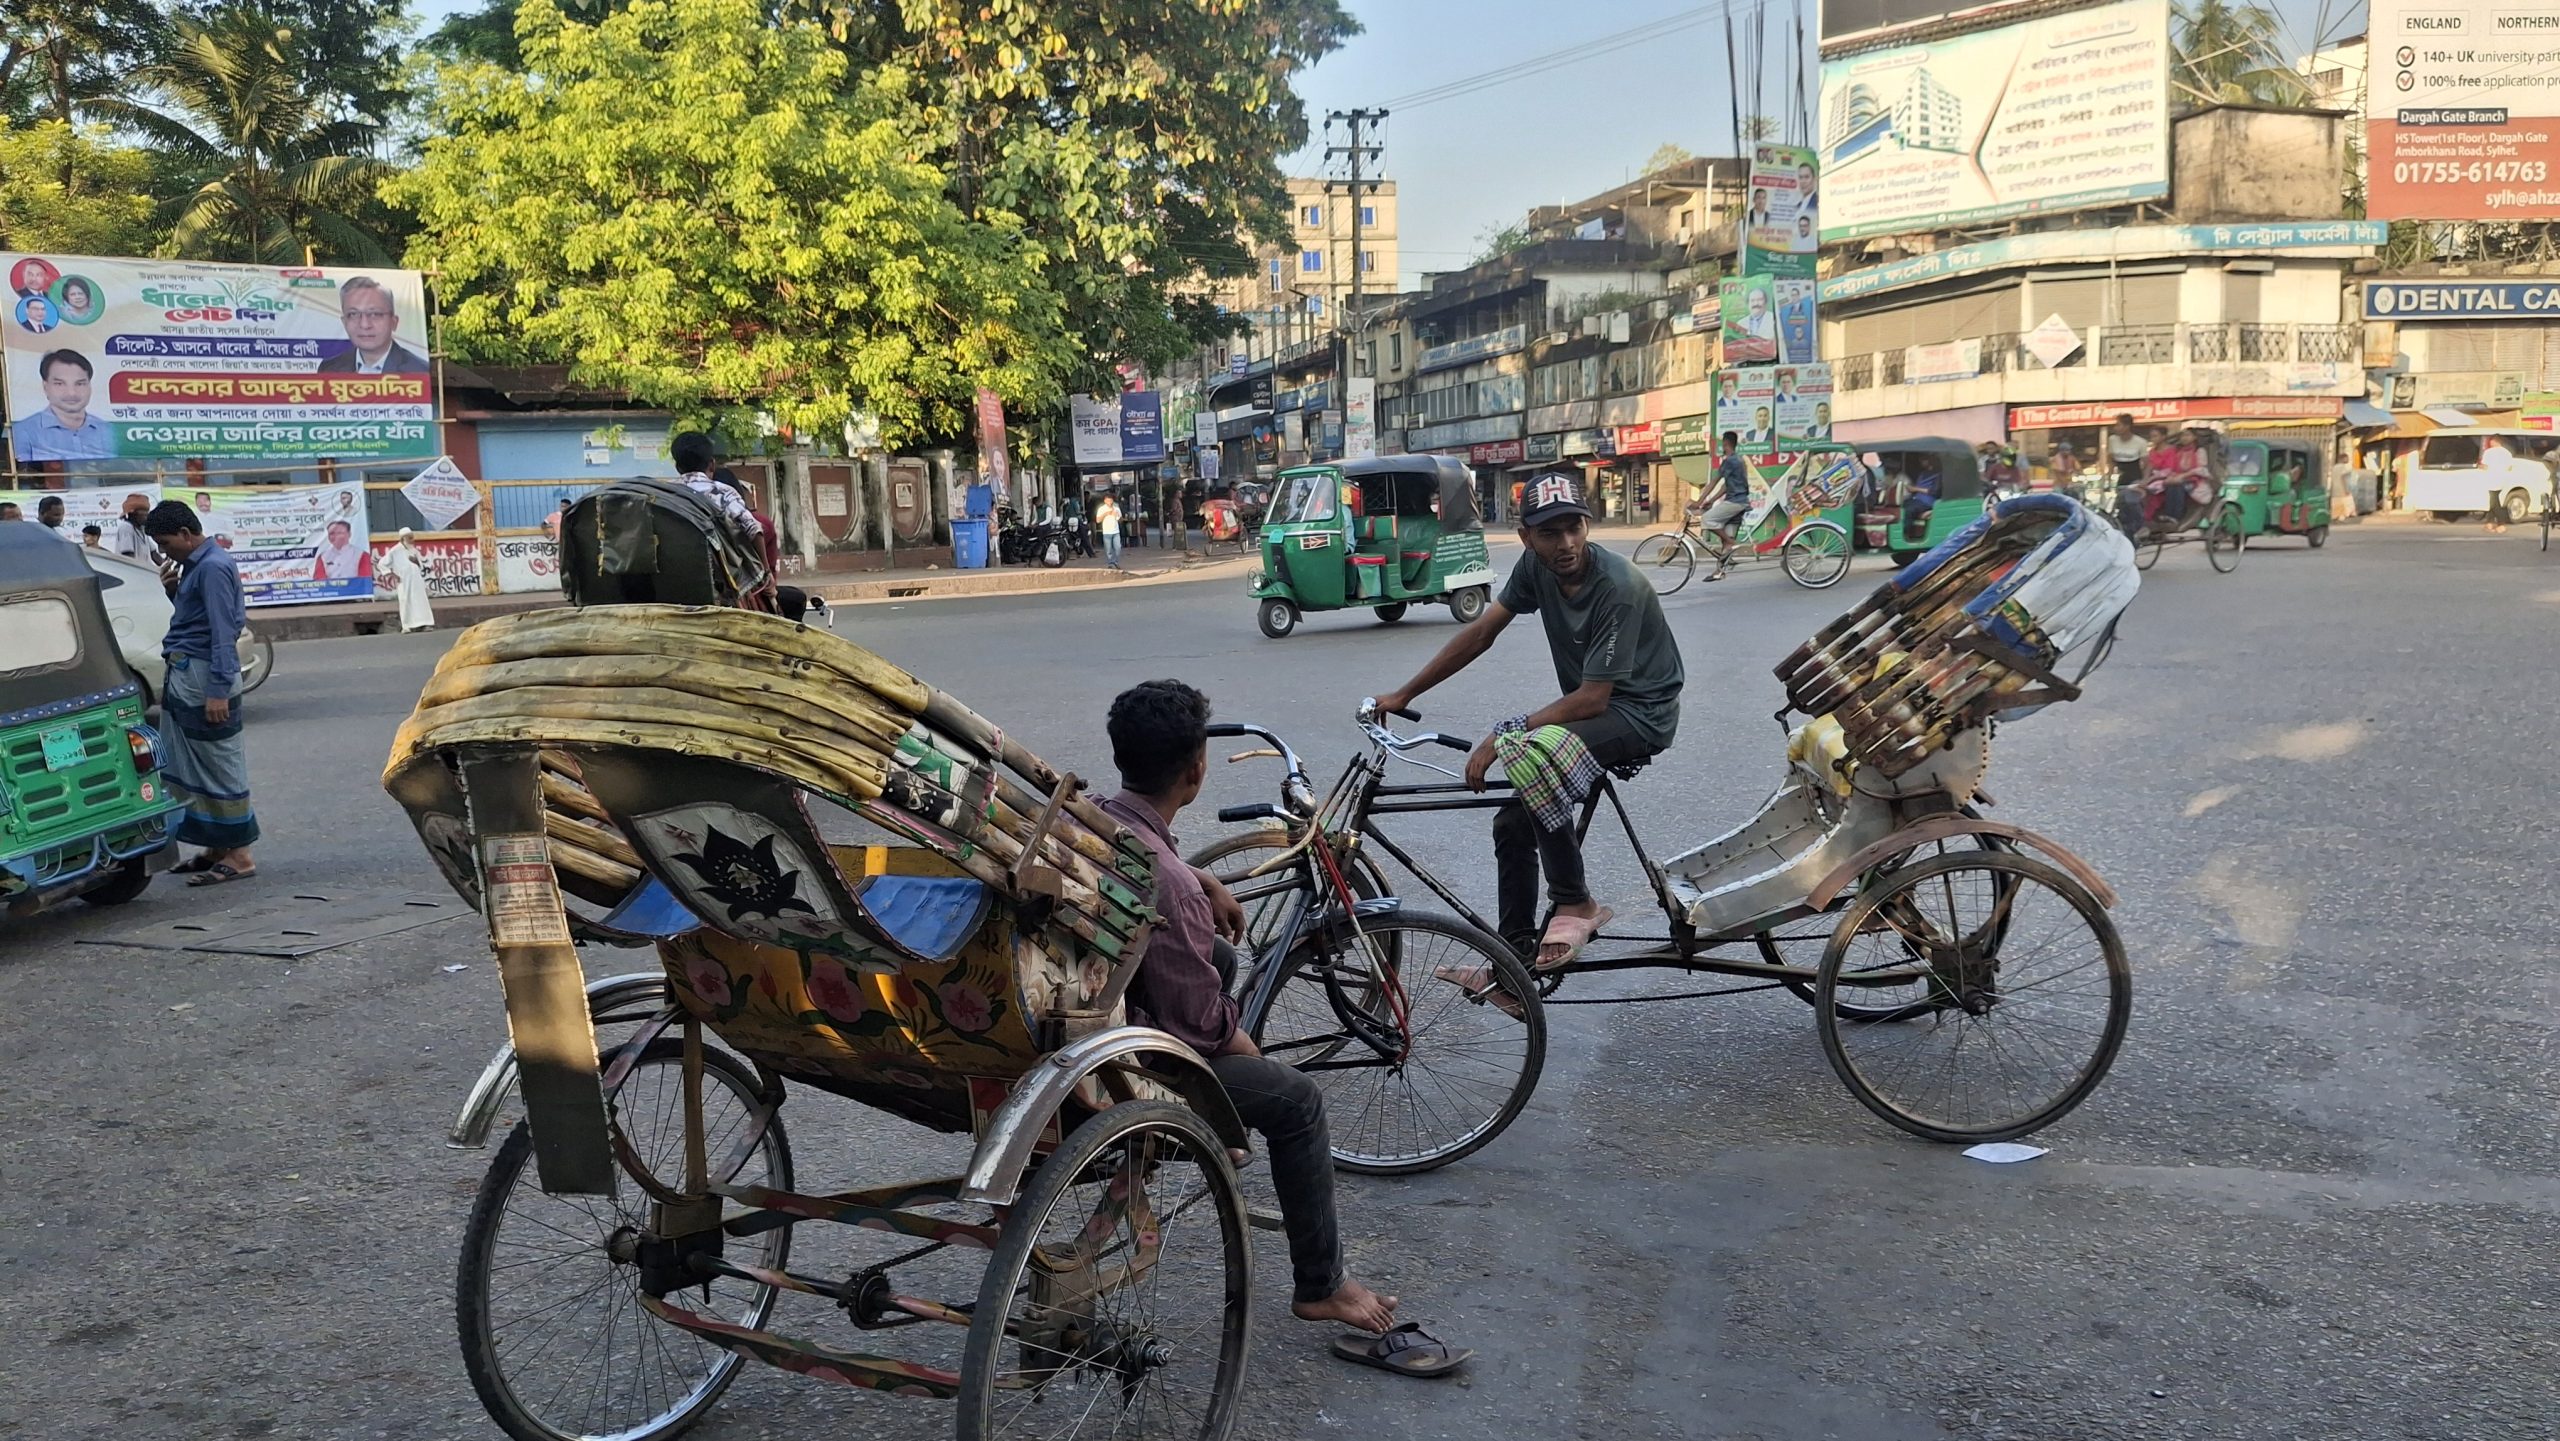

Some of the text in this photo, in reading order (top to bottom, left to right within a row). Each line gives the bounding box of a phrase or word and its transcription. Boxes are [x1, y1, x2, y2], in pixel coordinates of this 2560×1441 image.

[2406, 17, 2461, 29] ENGLAND
[2498, 17, 2559, 28] NORTHERN
[2423, 51, 2453, 63] 140+
[2457, 51, 2474, 62] UK
[2478, 51, 2534, 65] university
[2423, 76, 2456, 87] 100%
[2458, 75, 2481, 87] free
[2484, 75, 2544, 89] application
[2400, 110, 2505, 125] Dargah Gate Branch
[2395, 134, 2409, 144] HS
[2489, 132, 2524, 145] Dargah
[2525, 132, 2548, 143] Gate
[2395, 145, 2518, 158] Amborkhana Road, Sylhet.
[2394, 161, 2547, 184] 01755-614763
[2214, 227, 2231, 245] দি
[2398, 289, 2515, 311] DENTAL
[188, 324, 214, 335] জাতীয়
[115, 337, 168, 354] সিলেট-১
[171, 340, 212, 354] আসনে
[216, 341, 250, 355] ধানের
[121, 358, 159, 369] দেশনেত্রী
[162, 360, 186, 369] বেগম
[188, 359, 218, 369] খালেদা
[252, 360, 282, 370] অন্যতম
[127, 374, 423, 404] খন্দকার আব্দুল মুক্তাদির
[112, 406, 425, 420] ভাই এর জন্য আপনাদের দোয়া ও সমর্থন প্রত্যাশা করছি
[2022, 410, 2046, 424] The
[2048, 407, 2091, 422] Central
[126, 421, 425, 444] দেওয়ান জাকির হোসেন খাঁন
[1536, 475, 1576, 509] H
[424, 575, 480, 594] বাংলাদেশ
